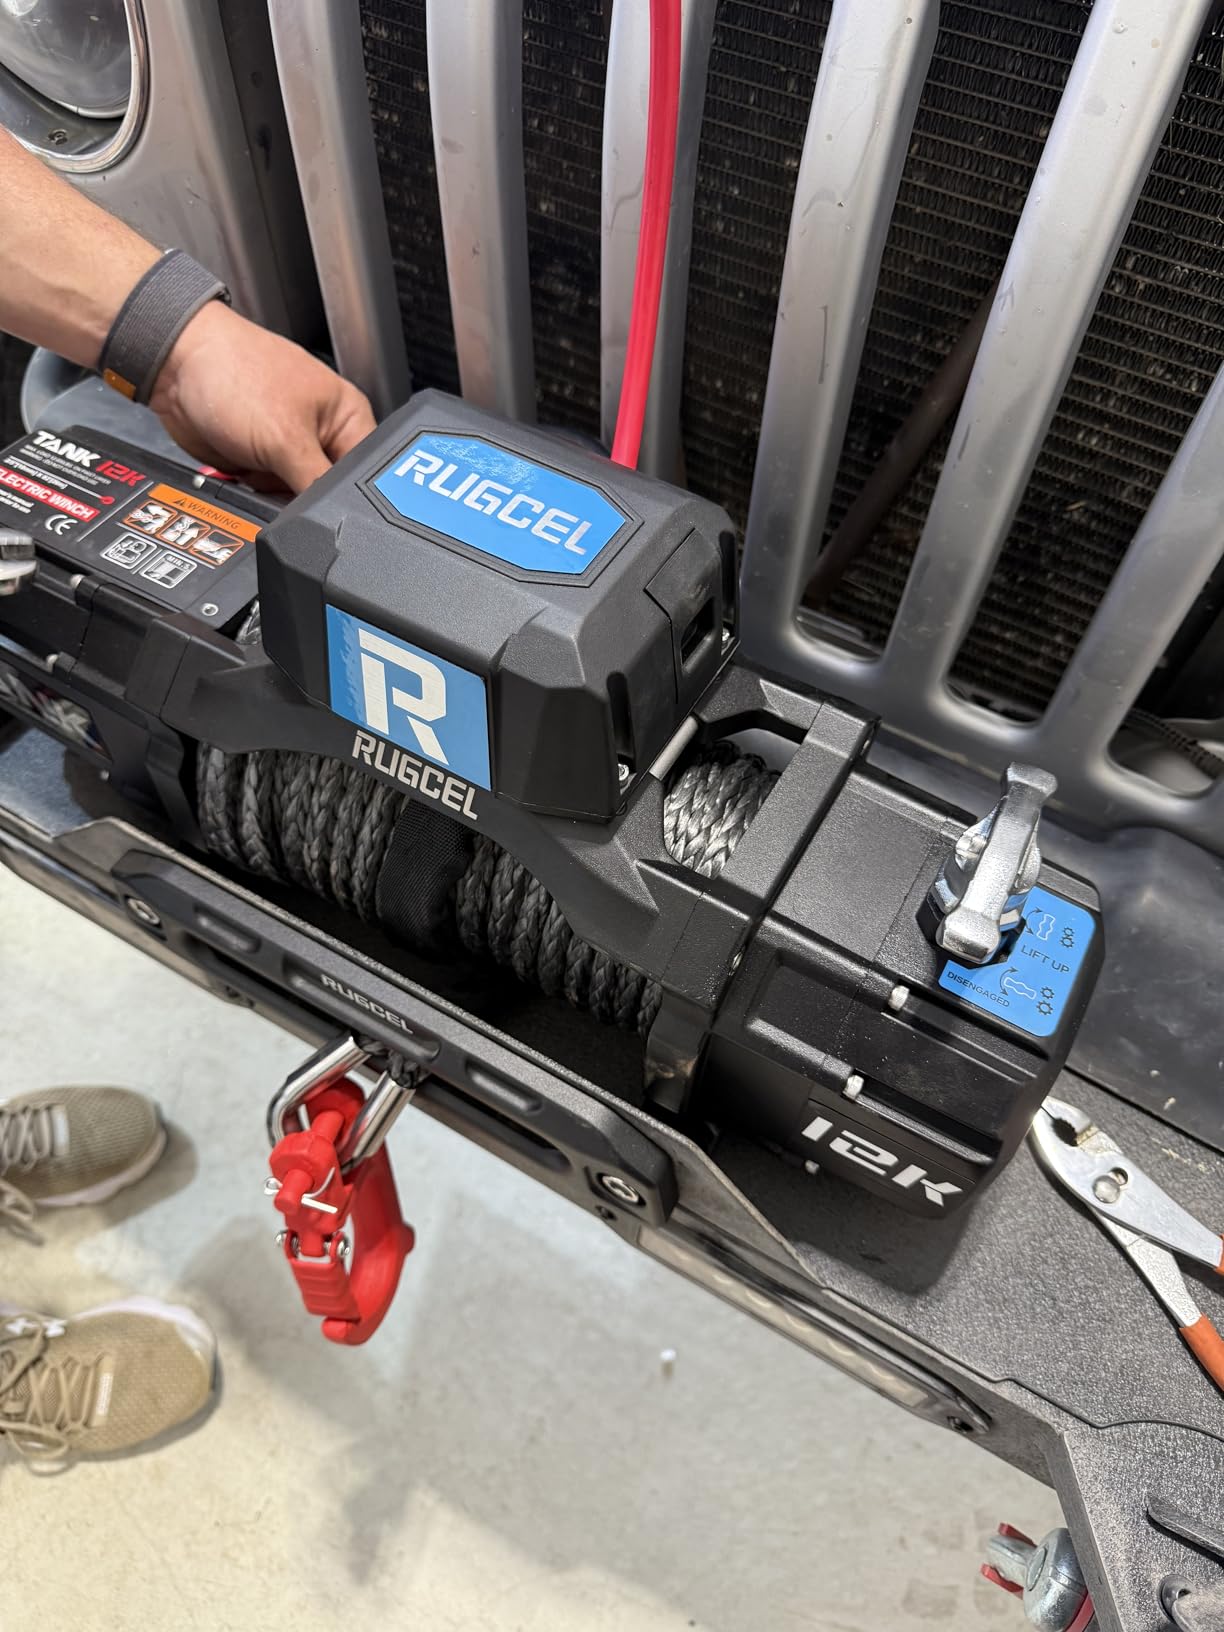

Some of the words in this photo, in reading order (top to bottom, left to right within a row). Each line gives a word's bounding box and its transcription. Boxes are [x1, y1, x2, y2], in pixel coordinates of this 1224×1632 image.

[33, 430, 101, 467] TANK
[95, 460, 146, 487] 12K
[48, 493, 95, 519] WINCH
[187, 502, 241, 529] WARNING
[394, 449, 593, 556] RUGCEL
[358, 627, 450, 767] R
[351, 729, 479, 821] RUGCEL
[1020, 944, 1050, 964] LIFT
[1051, 960, 1070, 974] UP
[320, 973, 414, 1035] RUGCEL
[947, 970, 1011, 1008] DISENGAGED
[801, 1115, 963, 1207] 12K
